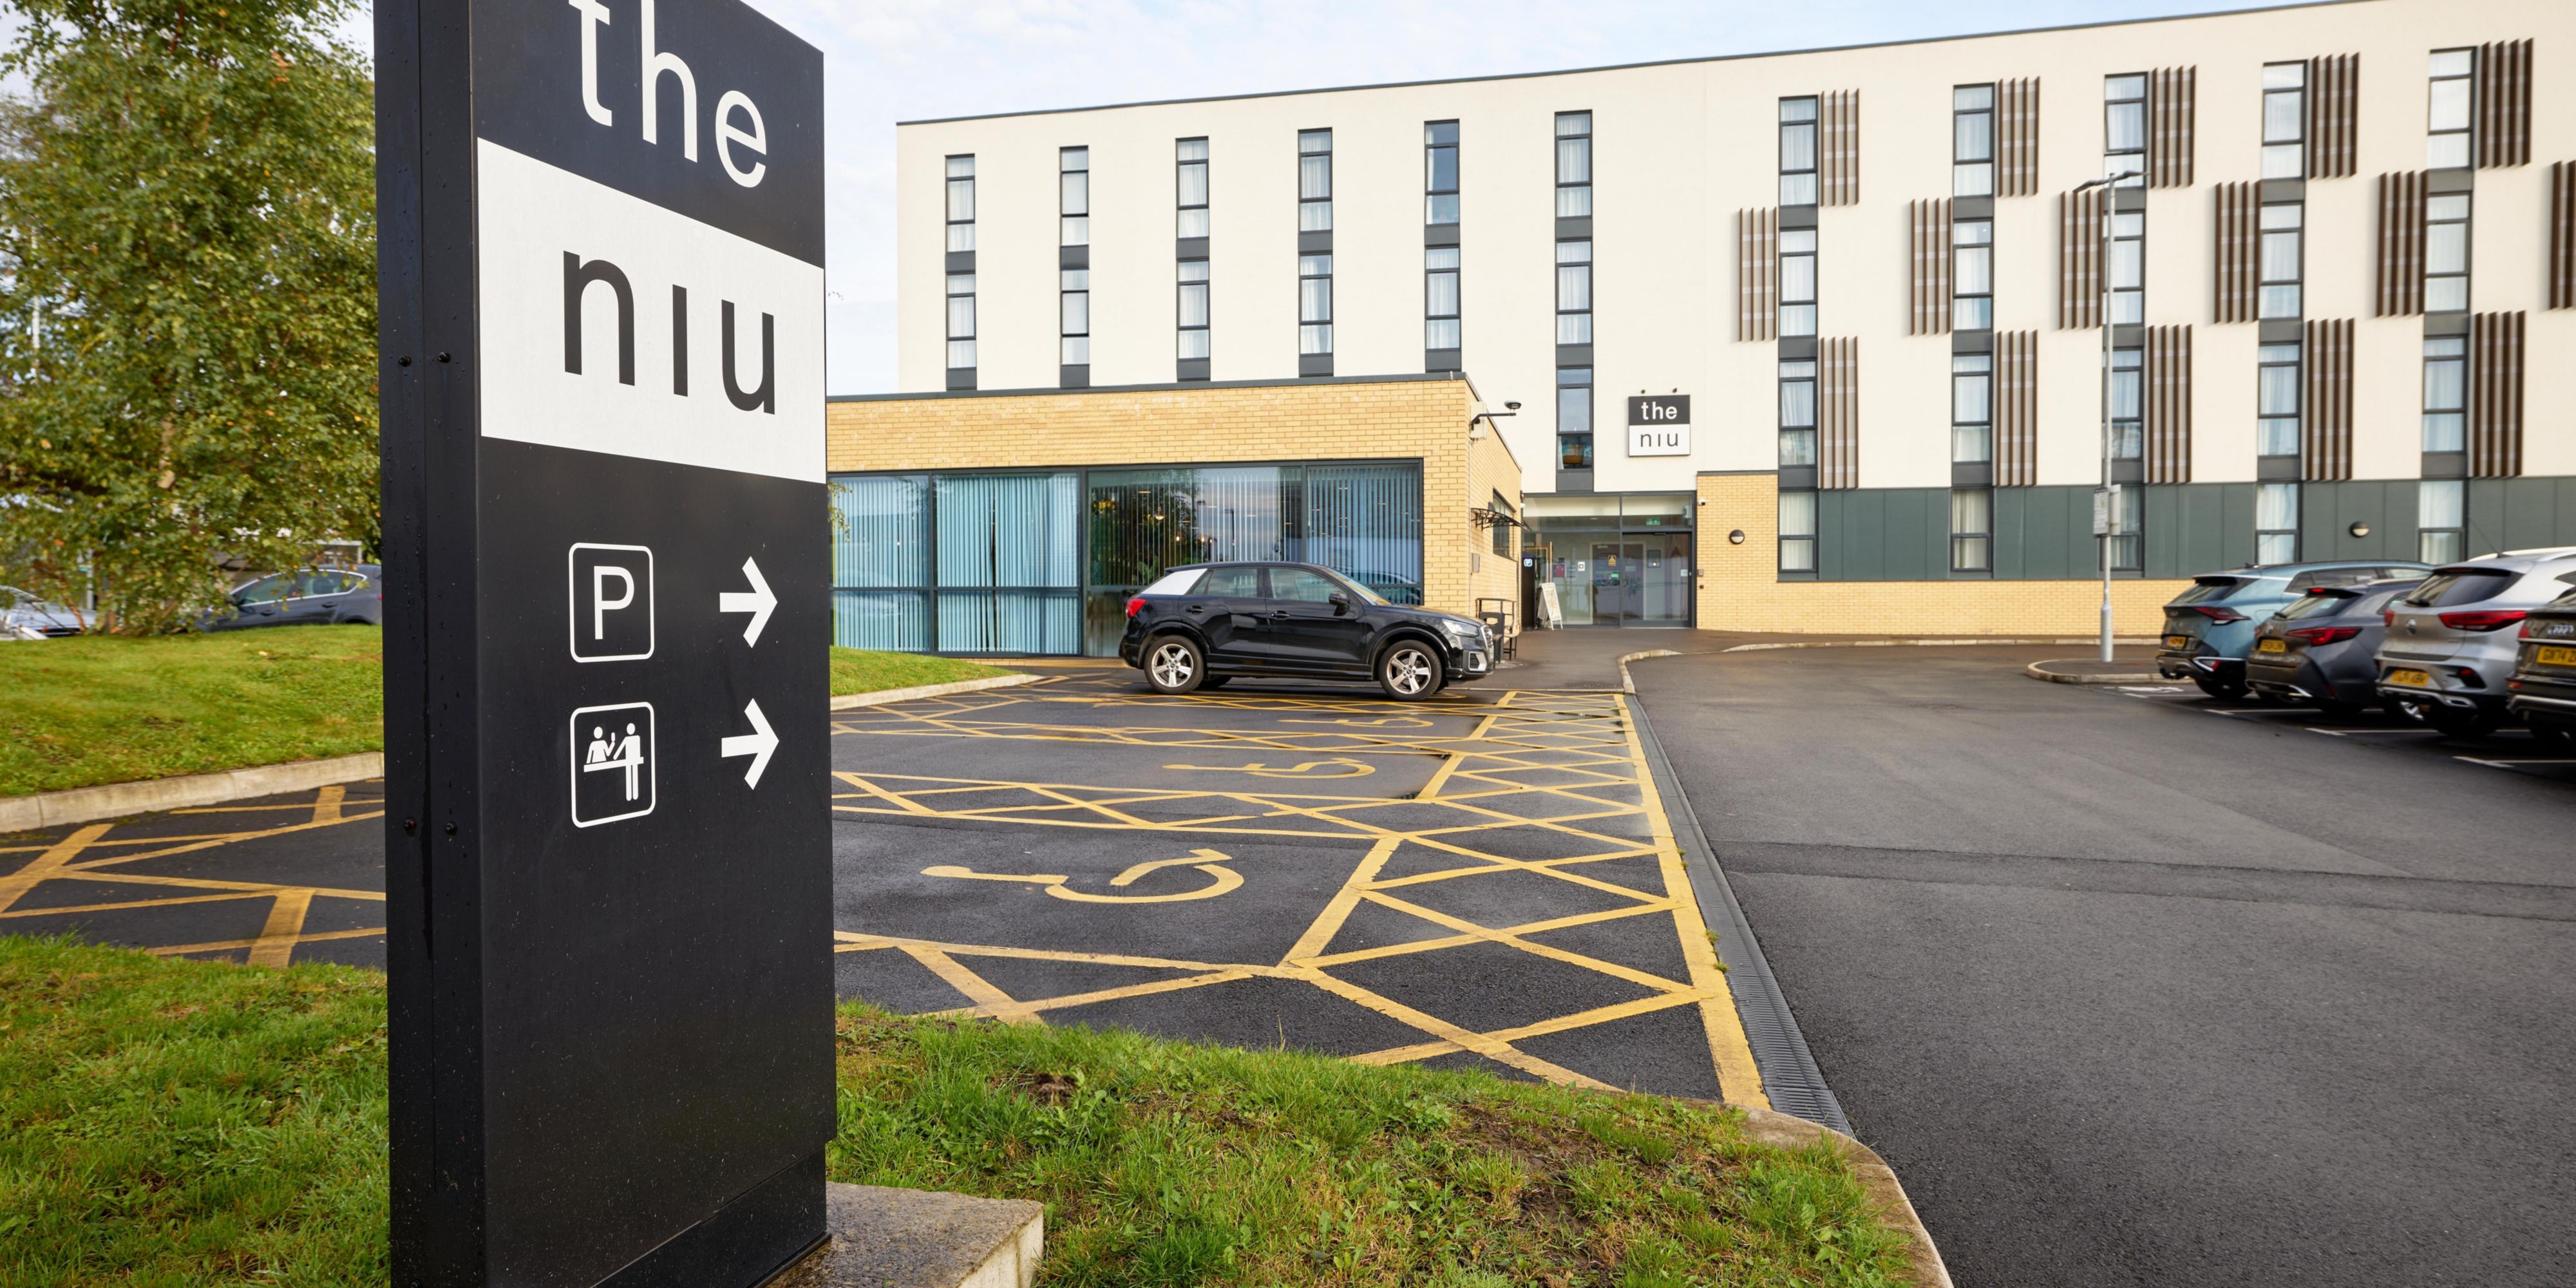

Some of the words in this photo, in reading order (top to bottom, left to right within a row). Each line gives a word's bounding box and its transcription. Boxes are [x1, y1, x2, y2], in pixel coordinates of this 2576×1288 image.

[569, 0, 767, 188] the
[564, 251, 775, 415] niu
[1640, 433, 1678, 448] niu
[1641, 401, 1678, 420] the
[594, 565, 634, 639] P
